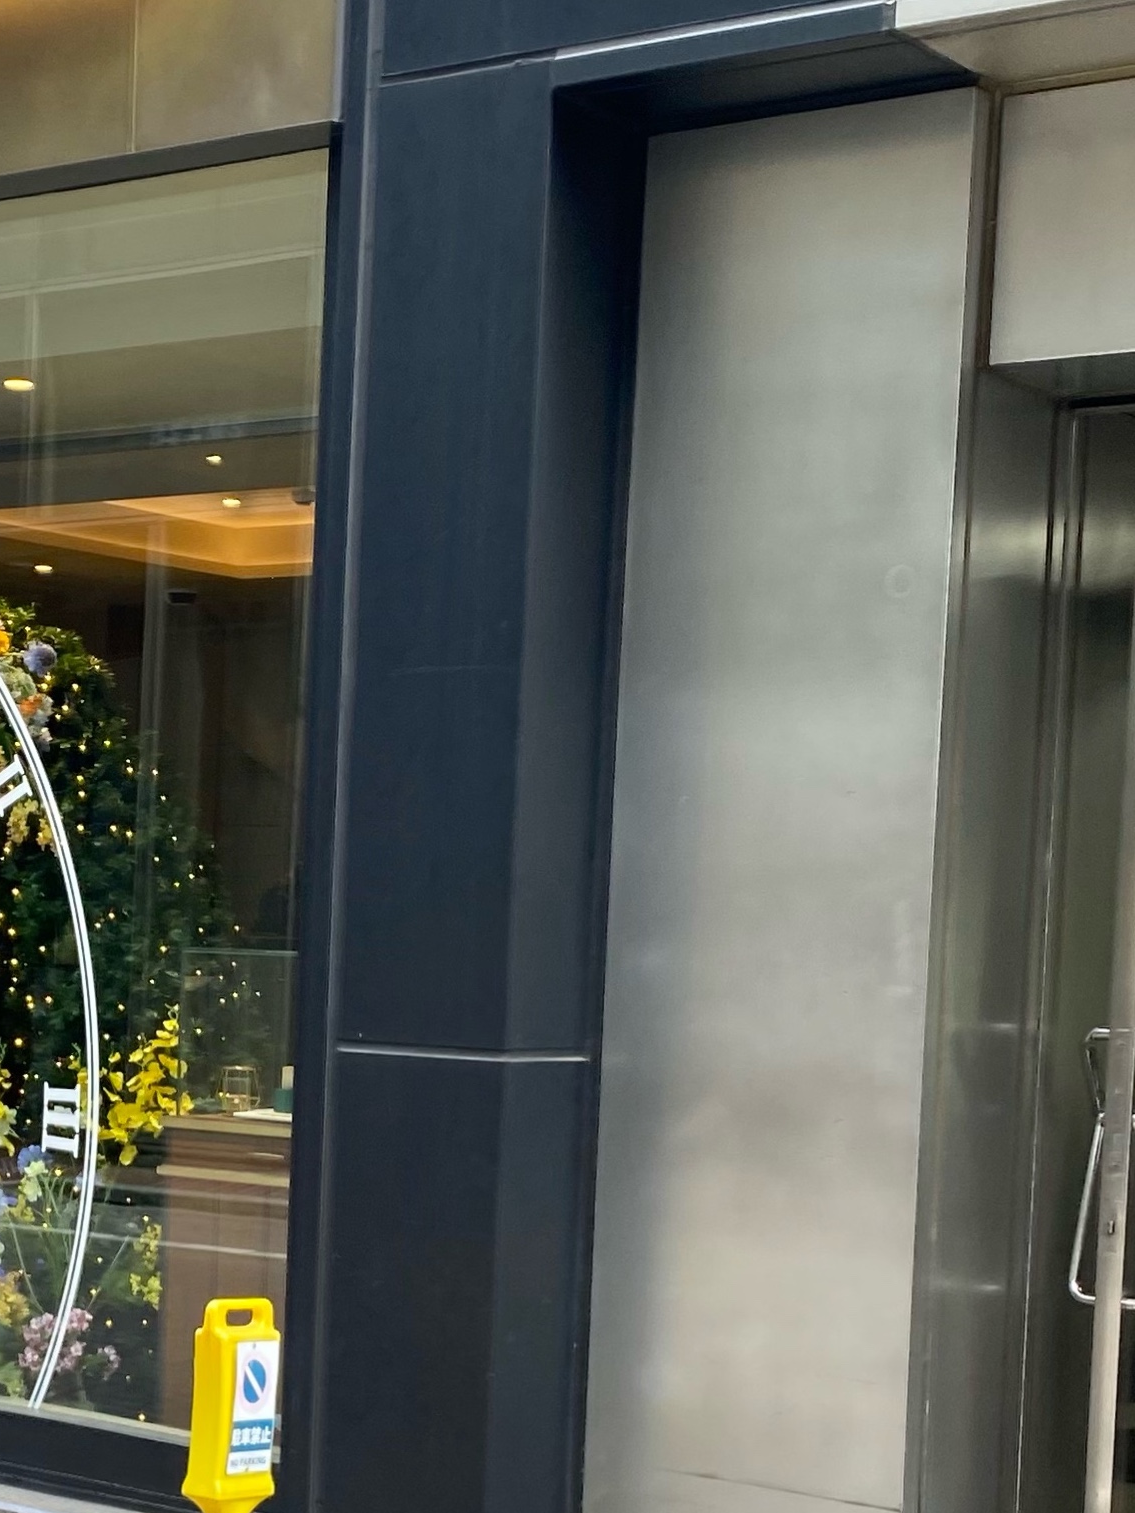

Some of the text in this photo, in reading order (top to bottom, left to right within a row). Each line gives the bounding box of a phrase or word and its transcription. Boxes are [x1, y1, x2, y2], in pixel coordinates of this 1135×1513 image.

[40, 1080, 81, 1159] III
[231, 1425, 271, 1447] 駐車禁止
[239, 1456, 267, 1466] PARKING
